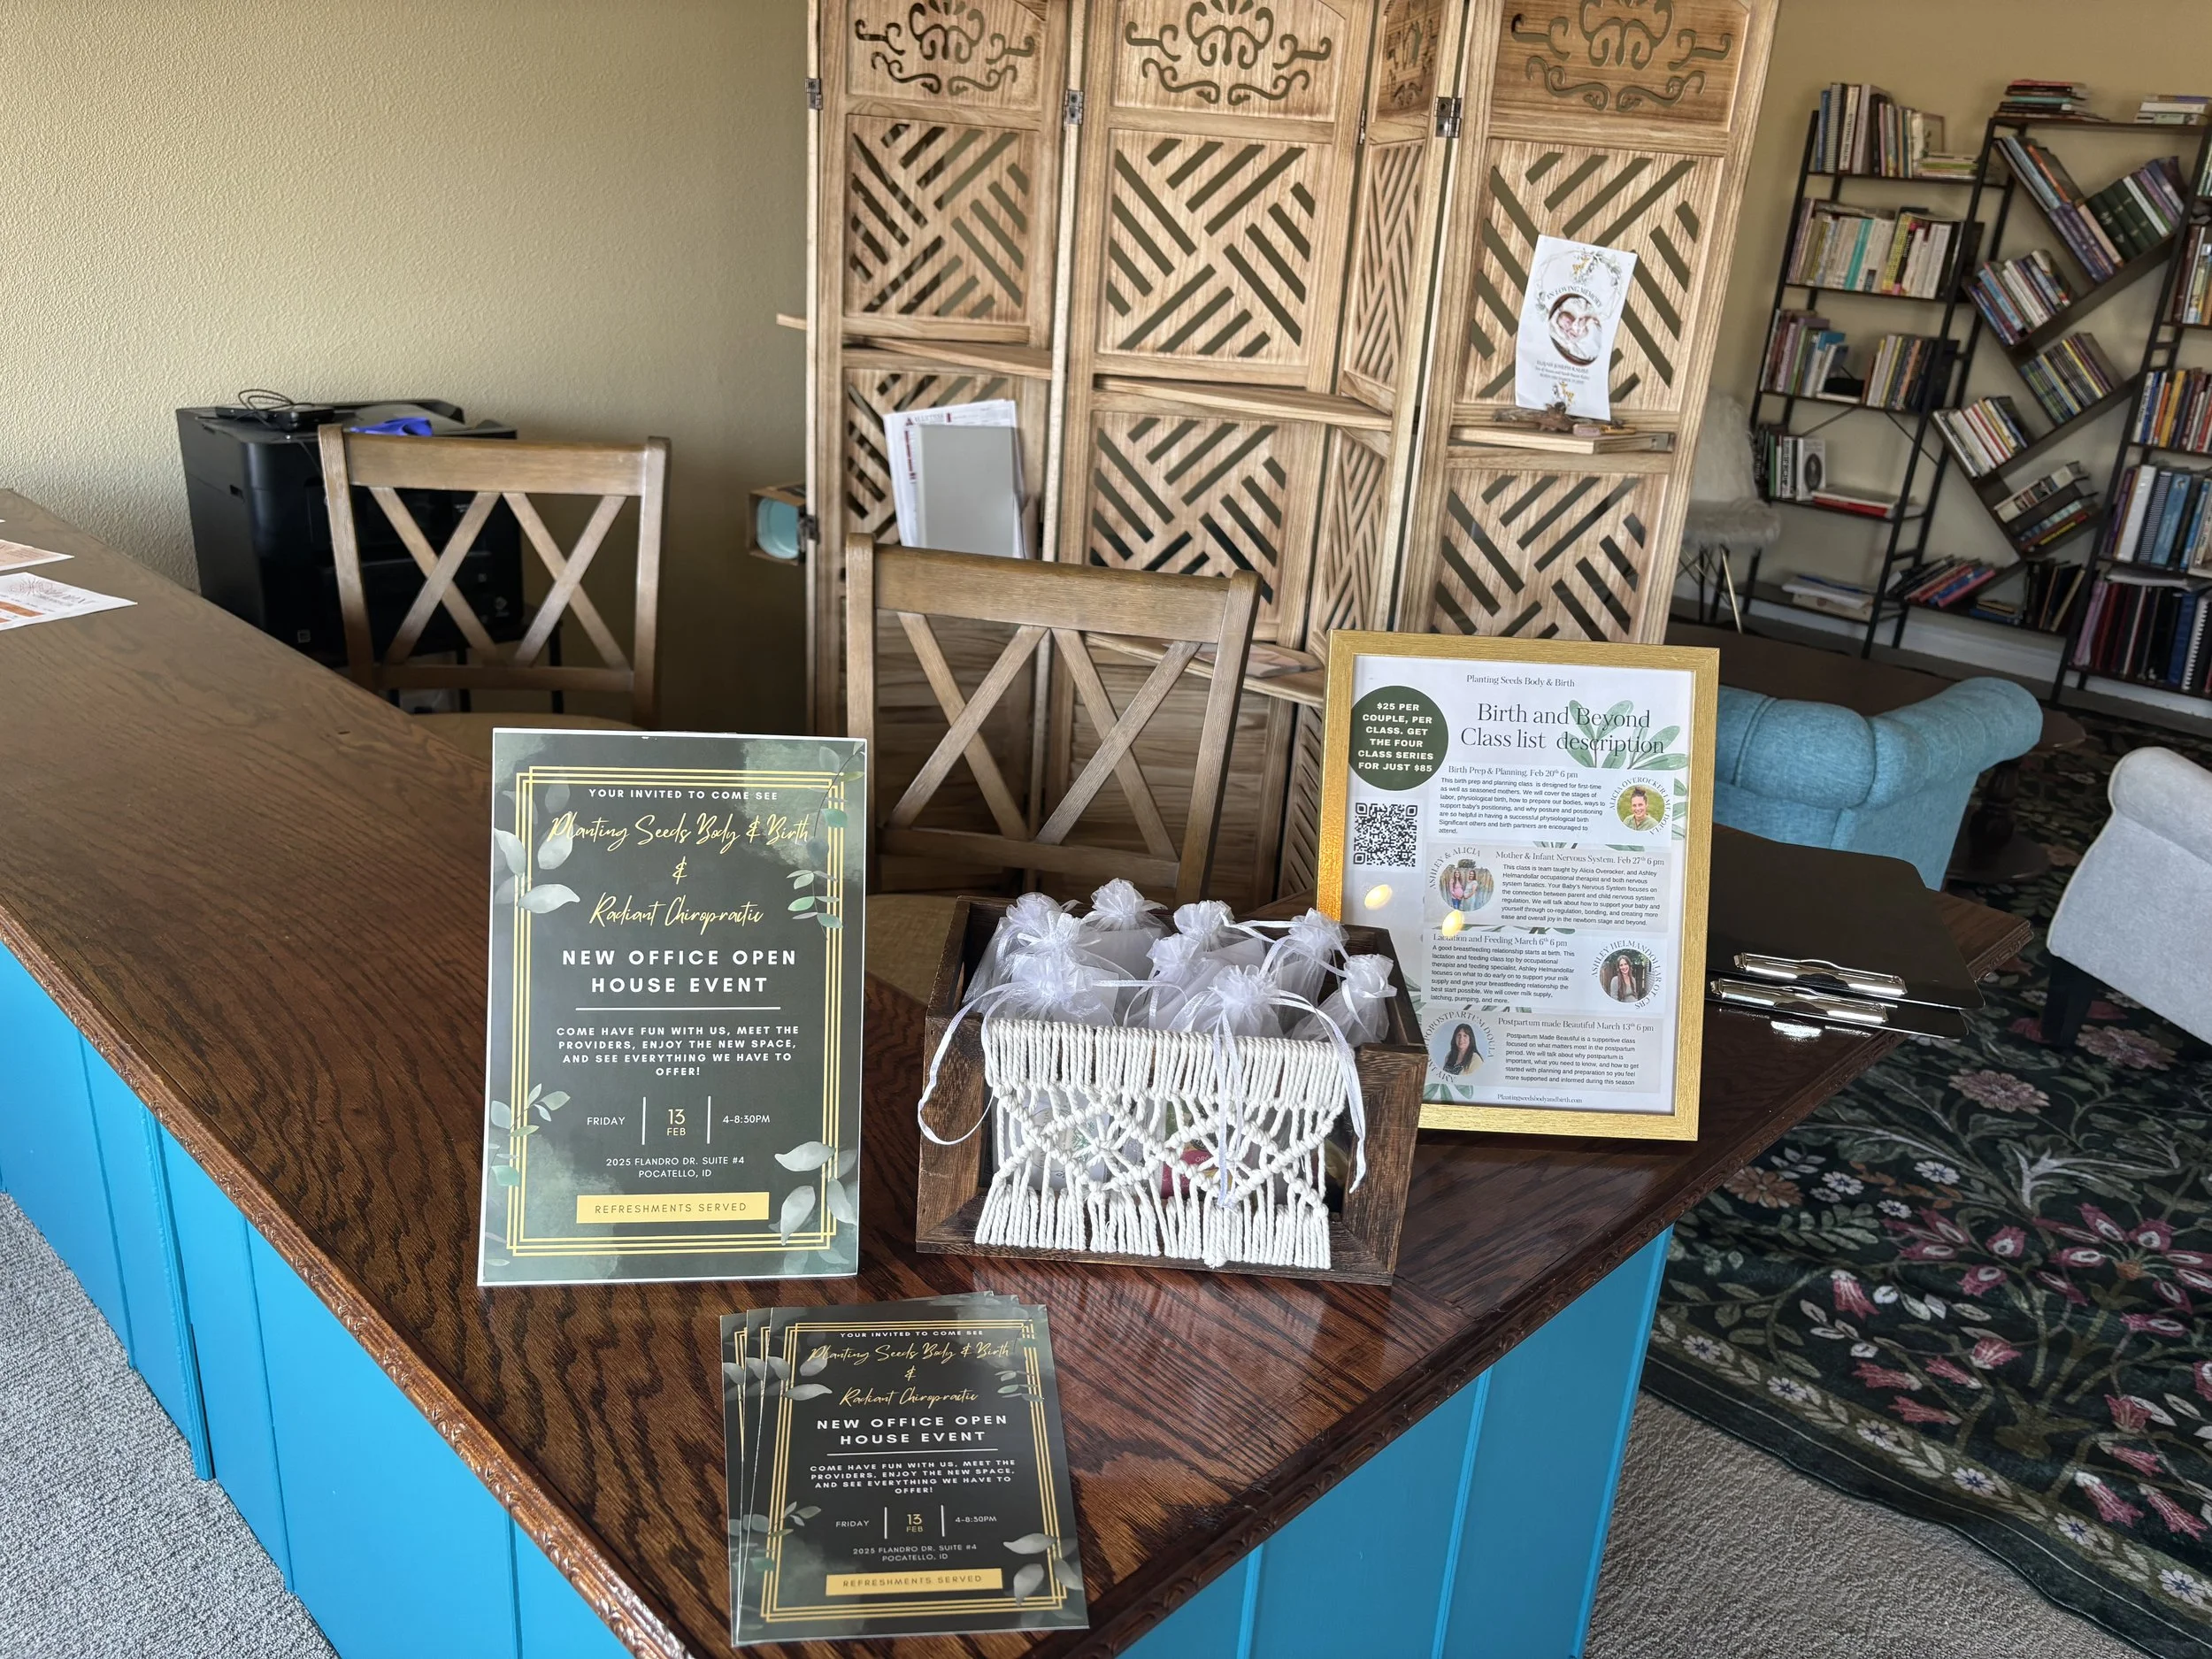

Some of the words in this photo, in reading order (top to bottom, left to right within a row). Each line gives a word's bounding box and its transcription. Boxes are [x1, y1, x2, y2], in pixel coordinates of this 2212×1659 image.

[1467, 675, 1499, 685] Planting
[1501, 676, 1523, 685] Seeds
[1525, 677, 1544, 687] Body
[1555, 679, 1575, 687] Birth
[1363, 714, 1409, 724] COUPLE,
[1479, 703, 1528, 723] Birth
[1533, 706, 1569, 725] and
[1576, 707, 1650, 730] Beyond
[1366, 726, 1403, 735] CLASS.
[1407, 727, 1428, 736] GET
[1461, 727, 1512, 749] Class
[1517, 729, 1547, 749] list
[1556, 732, 1664, 756] description
[1358, 750, 1392, 759] CLASS
[1395, 751, 1433, 760] SERIES
[1358, 762, 1379, 771] FOR
[1382, 763, 1410, 772] JUST
[1414, 764, 1432, 772] $85
[1448, 765, 1467, 774] Birth
[1470, 767, 1486, 776] Prep
[631, 789, 681, 798] INVITED
[711, 791, 749, 800] COME
[1609, 787, 1623, 810] ALICIA
[1622, 777, 1665, 794] OVEROCKER
[547, 811, 630, 851] Planting
[635, 813, 691, 845] Seeds
[696, 813, 740, 854] Body
[745, 815, 760, 843] &
[766, 814, 809, 846] Birth
[1587, 856, 1615, 864] System.
[672, 856, 687, 885] &
[1430, 856, 1444, 889] ASHLEY
[1453, 848, 1480, 856] ALICIA
[589, 892, 666, 927] Radiant
[665, 895, 764, 935] Chiropractic
[1484, 936, 1513, 945] Feeding
[563, 950, 615, 964] NEW
[628, 950, 718, 964] OFFICE
[733, 950, 795, 964] OPEN
[1592, 946, 1609, 977] ASHLEY
[592, 978, 675, 993] HOUSE
[690, 978, 767, 992] EVENT
[1498, 1018, 1540, 1027] Postpartum
[1563, 1020, 1595, 1029] Beautiful
[671, 1026, 703, 1035] WITH
[710, 1026, 730, 1035] US,
[559, 1041, 635, 1050] PROVIDERS,
[751, 1040, 796, 1048] SPACE,
[625, 1054, 706, 1063] EVERYTHING
[712, 1053, 730, 1062] WE
[736, 1053, 768, 1062] HAVE
[656, 1067, 699, 1076] OFFER!
[668, 1109, 685, 1125] 13
[722, 1115, 770, 1124] 4-8:30PM
[639, 1170, 698, 1179] POCATELLO,
[595, 1204, 691, 1214] REFRESHMENTS
[699, 1203, 746, 1212] SERVED
[807, 1345, 870, 1365] Planting
[875, 1343, 918, 1361] Seeds
[923, 1342, 956, 1363] Body
[961, 1343, 972, 1357] &
[976, 1341, 1009, 1359] Birth
[904, 1365, 916, 1381] &
[840, 1387, 900, 1407] Radiant
[899, 1386, 979, 1409] Chiropractic
[818, 1419, 860, 1429] NEW
[871, 1417, 944, 1428] OFFICE
[956, 1416, 1006, 1425] OPEN
[841, 1433, 910, 1445] HOUSE
[922, 1432, 985, 1442] EVENT
[907, 1514, 922, 1525] 13
[843, 1578, 931, 1587] REFRESHMENTS
